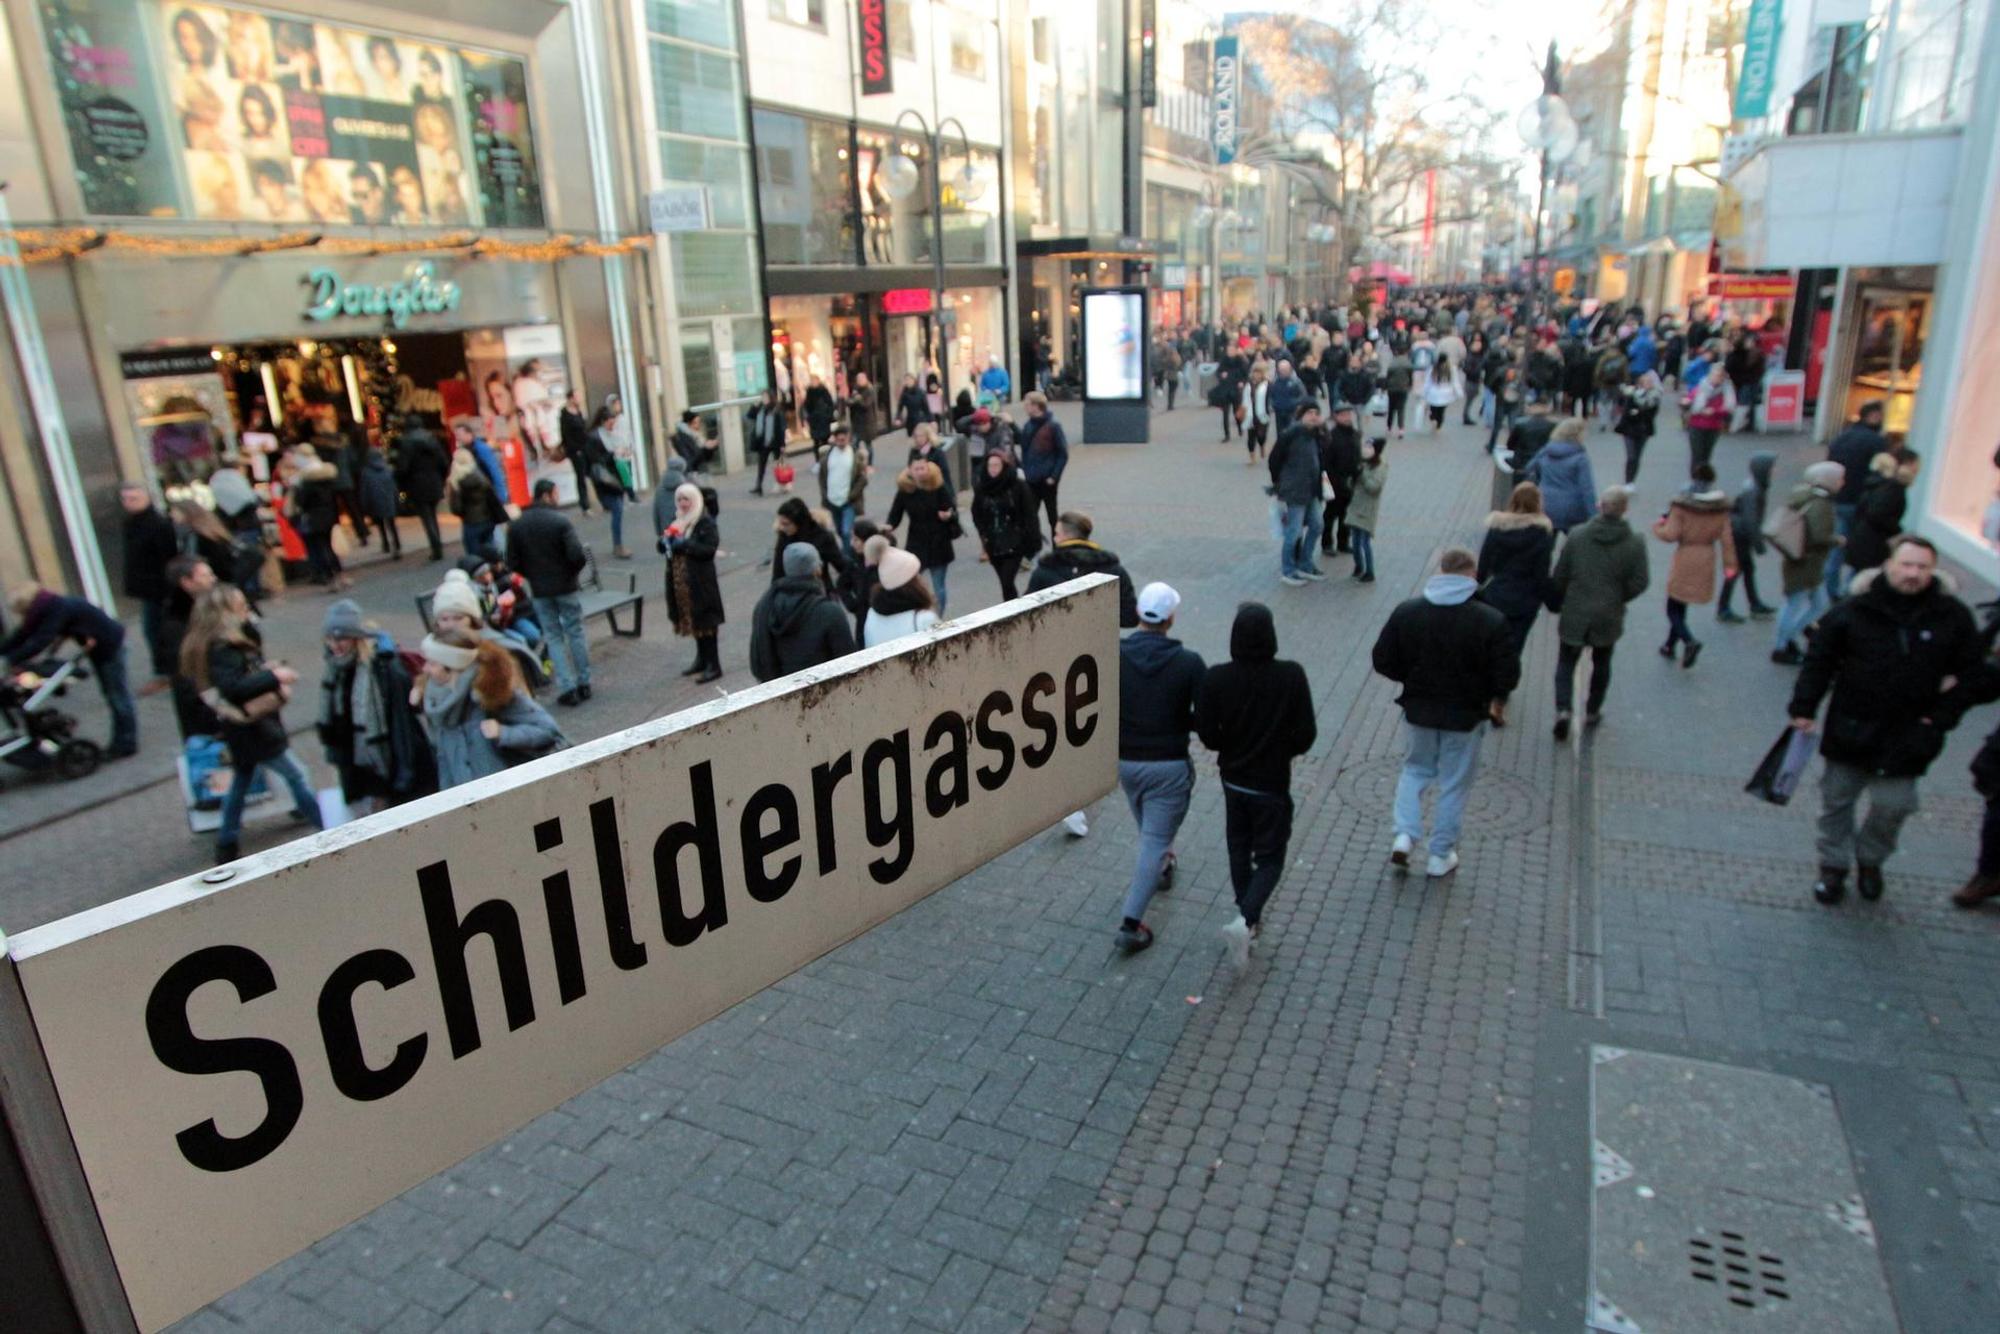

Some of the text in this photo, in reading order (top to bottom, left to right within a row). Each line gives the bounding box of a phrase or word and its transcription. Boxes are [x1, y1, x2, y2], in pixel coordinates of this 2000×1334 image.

[1214, 55, 1235, 152] ROLAND
[309, 260, 461, 330] Douglas
[146, 654, 1098, 1172] Schildergasse
